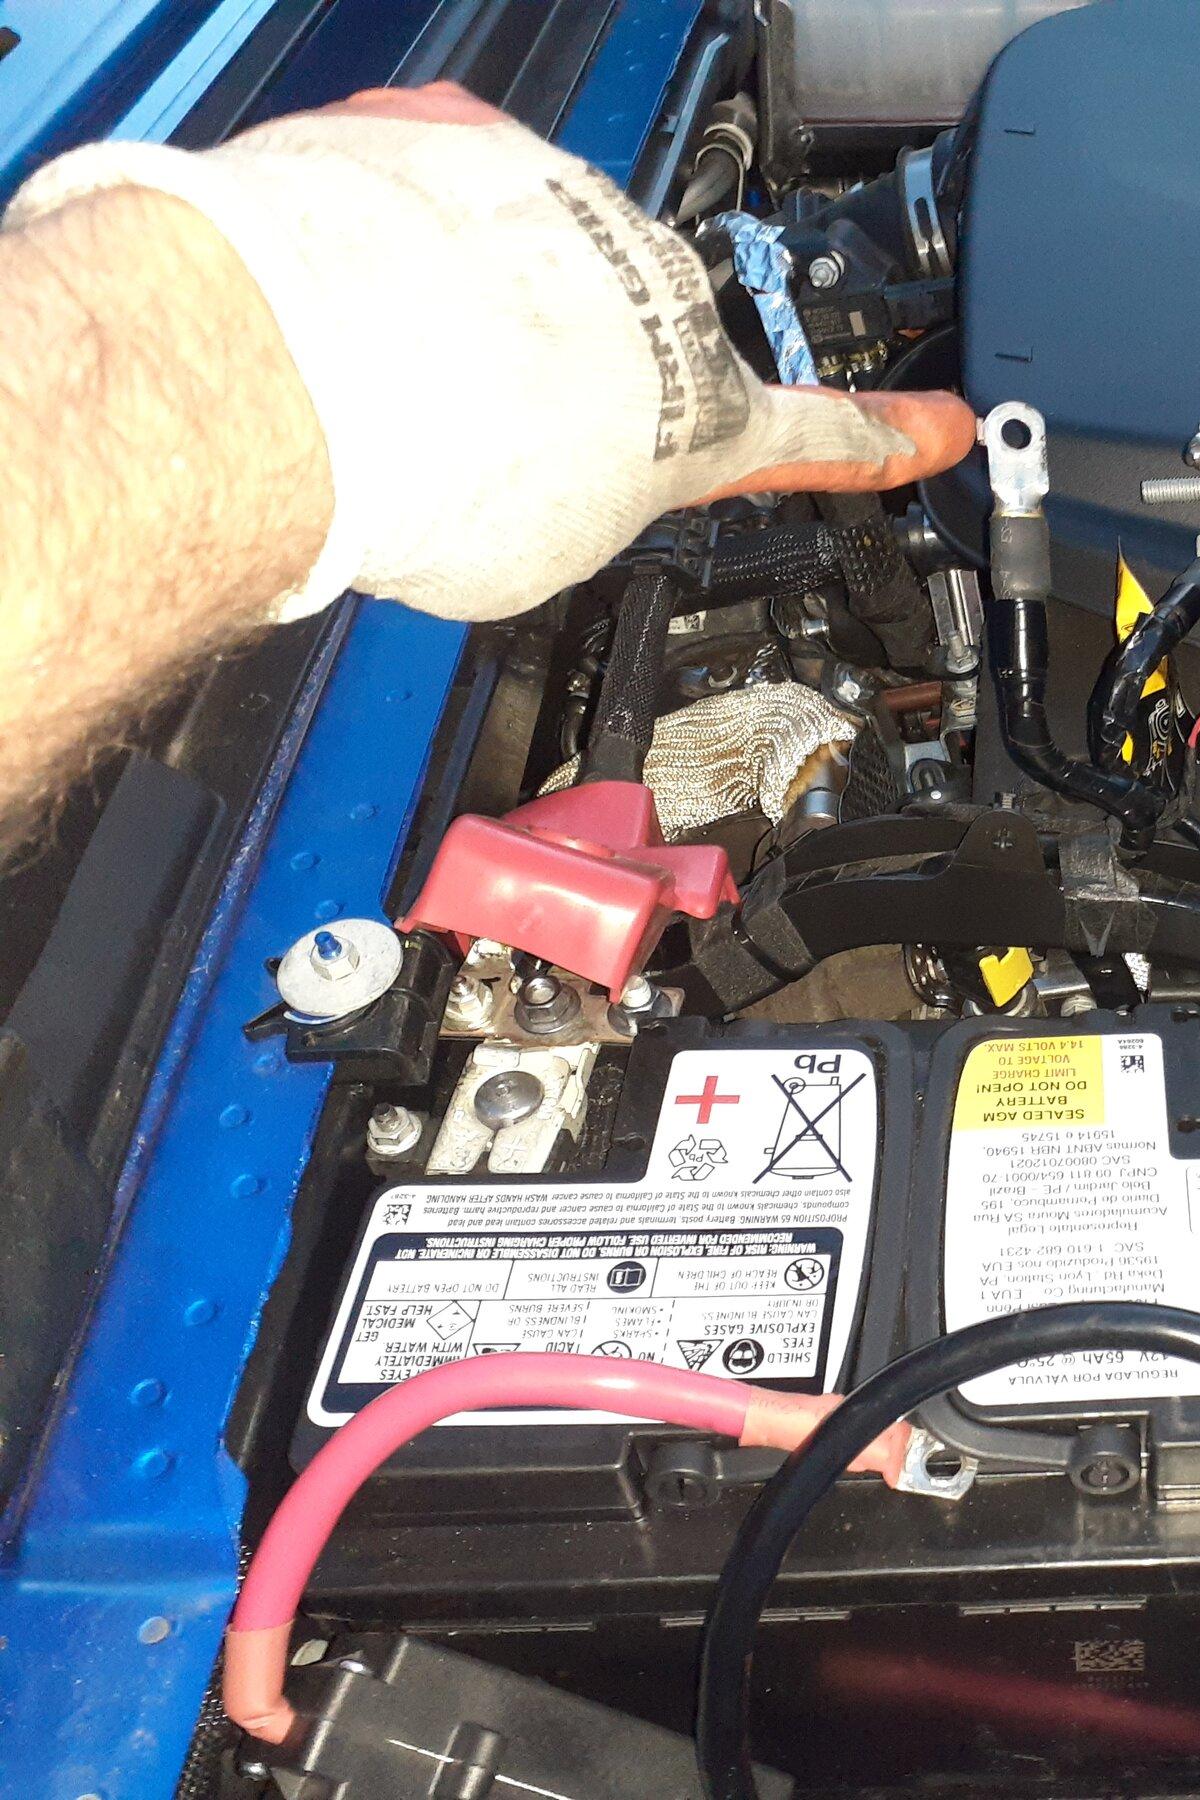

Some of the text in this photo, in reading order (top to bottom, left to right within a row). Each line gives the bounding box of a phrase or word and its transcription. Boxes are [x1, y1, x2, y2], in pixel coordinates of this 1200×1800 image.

[1019, 1042, 1055, 1051] VOLTS
[793, 1054, 841, 1074] Pb
[999, 1055, 1070, 1065] VOLTAGE TO
[992, 1068, 1075, 1079] LIMIT CHARGE
[976, 1081, 1086, 1093] DO NOT OPEN!
[996, 1096, 1067, 1106] BATTERY
[983, 1109, 1084, 1122] SEALED AGM
[1067, 1144, 1102, 1153] ABNT
[688, 1153, 704, 1163] Pb
[1101, 1155, 1130, 1165] SAC
[468, 1195, 493, 1203] AFTER
[495, 1194, 523, 1203] HANDS
[524, 1194, 548, 1202] WASH
[423, 1206, 459, 1215] Batteries
[487, 1205, 539, 1215] reproductive
[541, 1206, 557, 1214] and
[559, 1206, 587, 1214] cancer
[589, 1205, 613, 1213] cause
[615, 1205, 623, 1213] to
[626, 1204, 665, 1213] California
[666, 1204, 675, 1212] of
[678, 1204, 699, 1212] State
[701, 1203, 714, 1211] the
[727, 1202, 754, 1211] known
[757, 1202, 798, 1211] chemicals
[447, 1219, 465, 1228] lead
[467, 1219, 483, 1228] and
[485, 1219, 503, 1228] lead
[505, 1219, 536, 1227] contain
[538, 1218, 587, 1226] accessories
[589, 1218, 618, 1227] related
[619, 1217, 635, 1225] and
[638, 1216, 677, 1225] terminals
[706, 1215, 735, 1224] Battery
[781, 1215, 791, 1223] 65
[497, 1237, 547, 1247] CHARGING
[548, 1236, 587, 1247] PROPER
[587, 1234, 627, 1246] FOLLOW
[650, 1234, 697, 1244] INVERTED
[699, 1234, 718, 1244] FOR
[720, 1232, 793, 1244] RECOMMENDED
[395, 1248, 416, 1259] NOT
[476, 1248, 490, 1258] OR
[491, 1248, 558, 1258] DISASSEMBLE
[560, 1247, 580, 1257] NOT
[582, 1247, 596, 1257] DO
[633, 1246, 647, 1256] OR
[650, 1245, 703, 1256] EXPLOSION
[730, 1244, 741, 1254] OF
[743, 1244, 766, 1254] RISK
[767, 1243, 816, 1254] WARNING:
[527, 1273, 599, 1283] INSTRUCTIONS
[433, 1284, 459, 1293] OPEN
[463, 1284, 482, 1293] NOT
[991, 1289, 1022, 1299] EUA
[366, 1305, 433, 1315] HELP FAST.
[508, 1304, 583, 1313] SEVERE BURNS
[362, 1318, 416, 1328] MEDICAL
[525, 1316, 580, 1325] BLINDNESS
[521, 1329, 577, 1338] CAN CAUSE
[704, 1323, 815, 1335] EXPLOSIVE GASES
[355, 1331, 379, 1342] GET
[432, 1342, 462, 1352] WITH
[545, 1342, 574, 1353] ACID
[767, 1352, 811, 1363] SHIELD
[1082, 1351, 1124, 1365] 65Ah
[379, 1369, 411, 1380] EYES
[1073, 1373, 1100, 1382] POR
[1104, 1369, 1177, 1381] REGULADA
